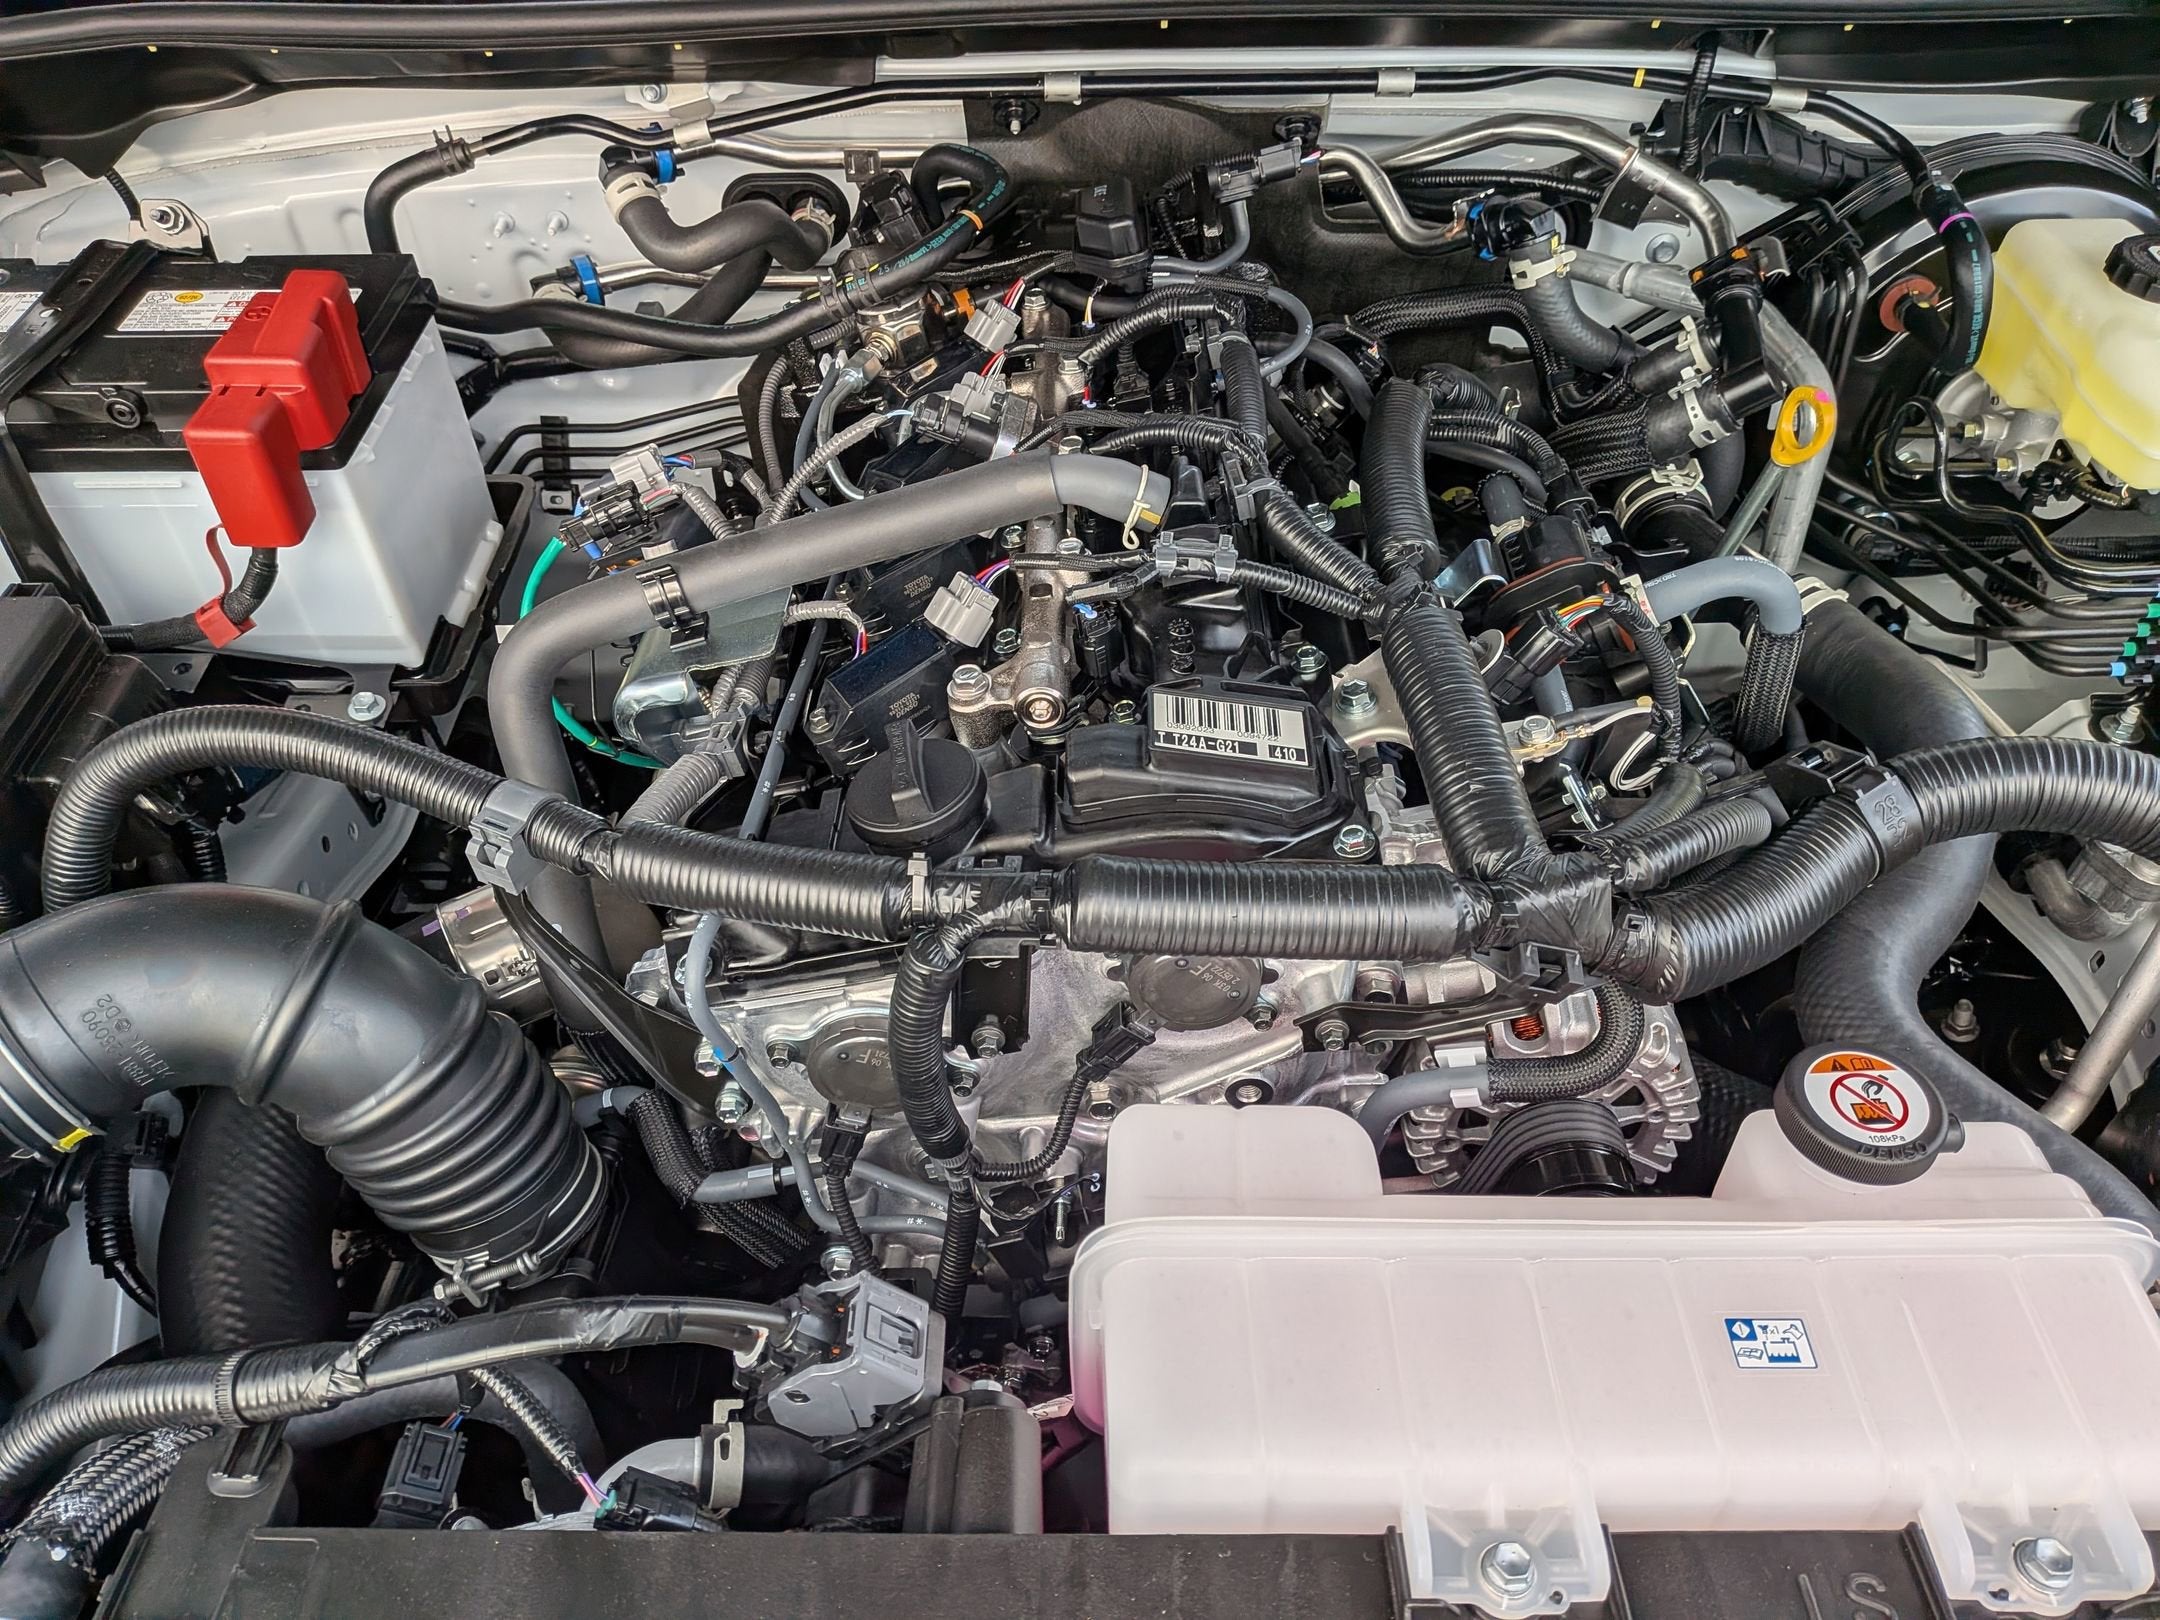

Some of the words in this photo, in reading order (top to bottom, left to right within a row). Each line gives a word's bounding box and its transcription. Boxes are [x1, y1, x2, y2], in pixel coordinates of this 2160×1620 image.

[889, 692, 916, 710] TOYOTA
[896, 701, 919, 719] DENSO
[1173, 733, 1240, 754] T24A-G21
[1274, 746, 1297, 761] 410
[1874, 794, 1902, 826] 28
[1868, 1134, 1906, 1143] 108kPa
[1858, 1141, 1928, 1161] DENSO
